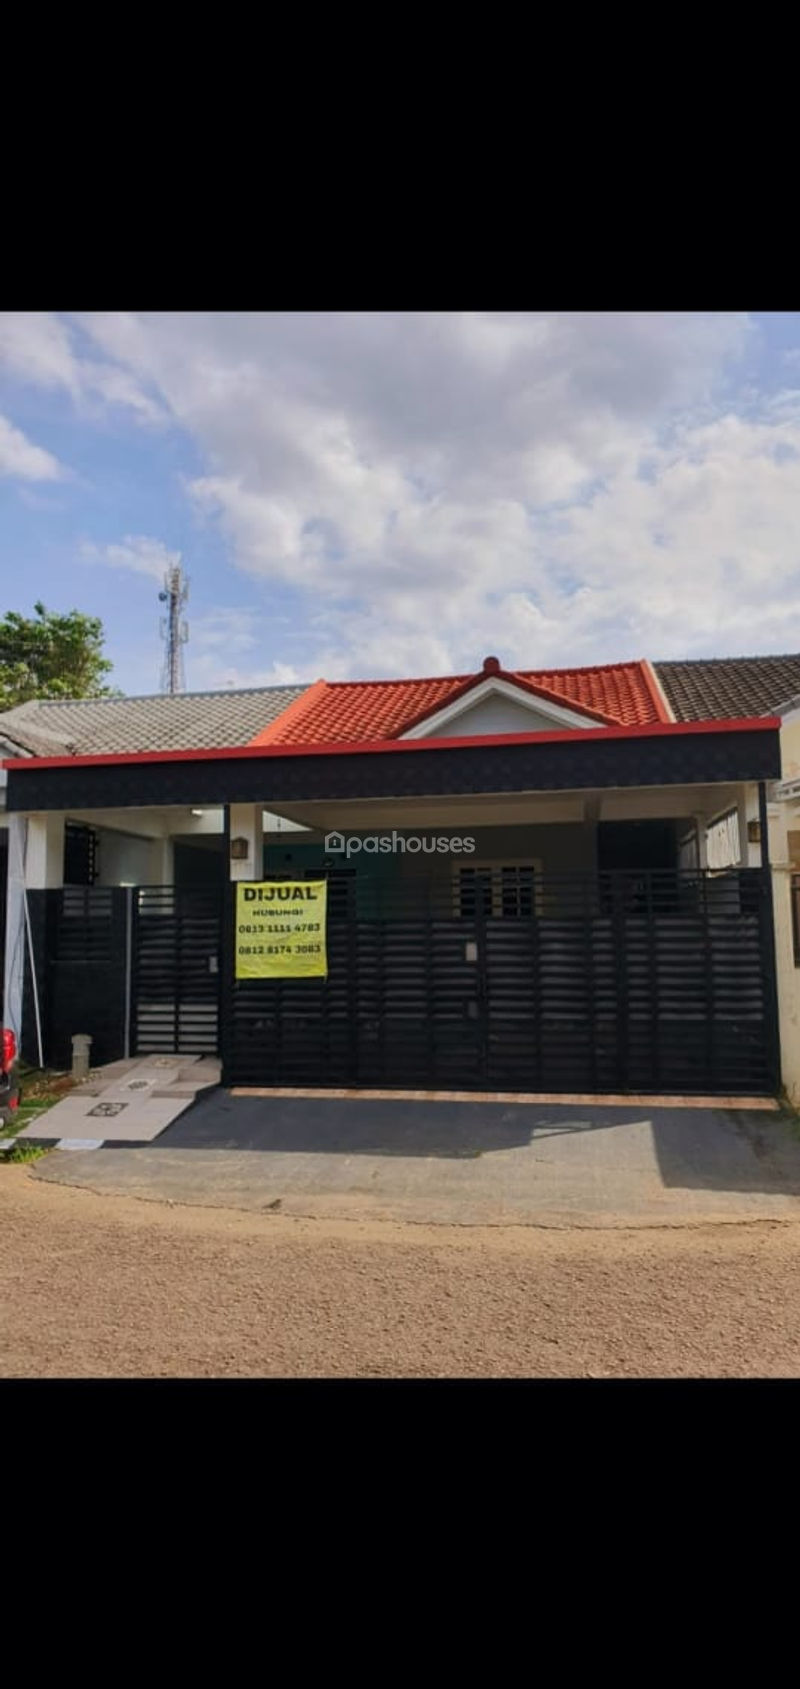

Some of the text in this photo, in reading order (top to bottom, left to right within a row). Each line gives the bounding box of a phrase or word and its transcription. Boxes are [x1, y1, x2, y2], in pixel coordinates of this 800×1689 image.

[244, 886, 318, 902] DIJUAL
[252, 908, 304, 917] HUBUNGI
[238, 924, 264, 934] 0813
[267, 923, 292, 933] 1111
[238, 945, 264, 955] 0812
